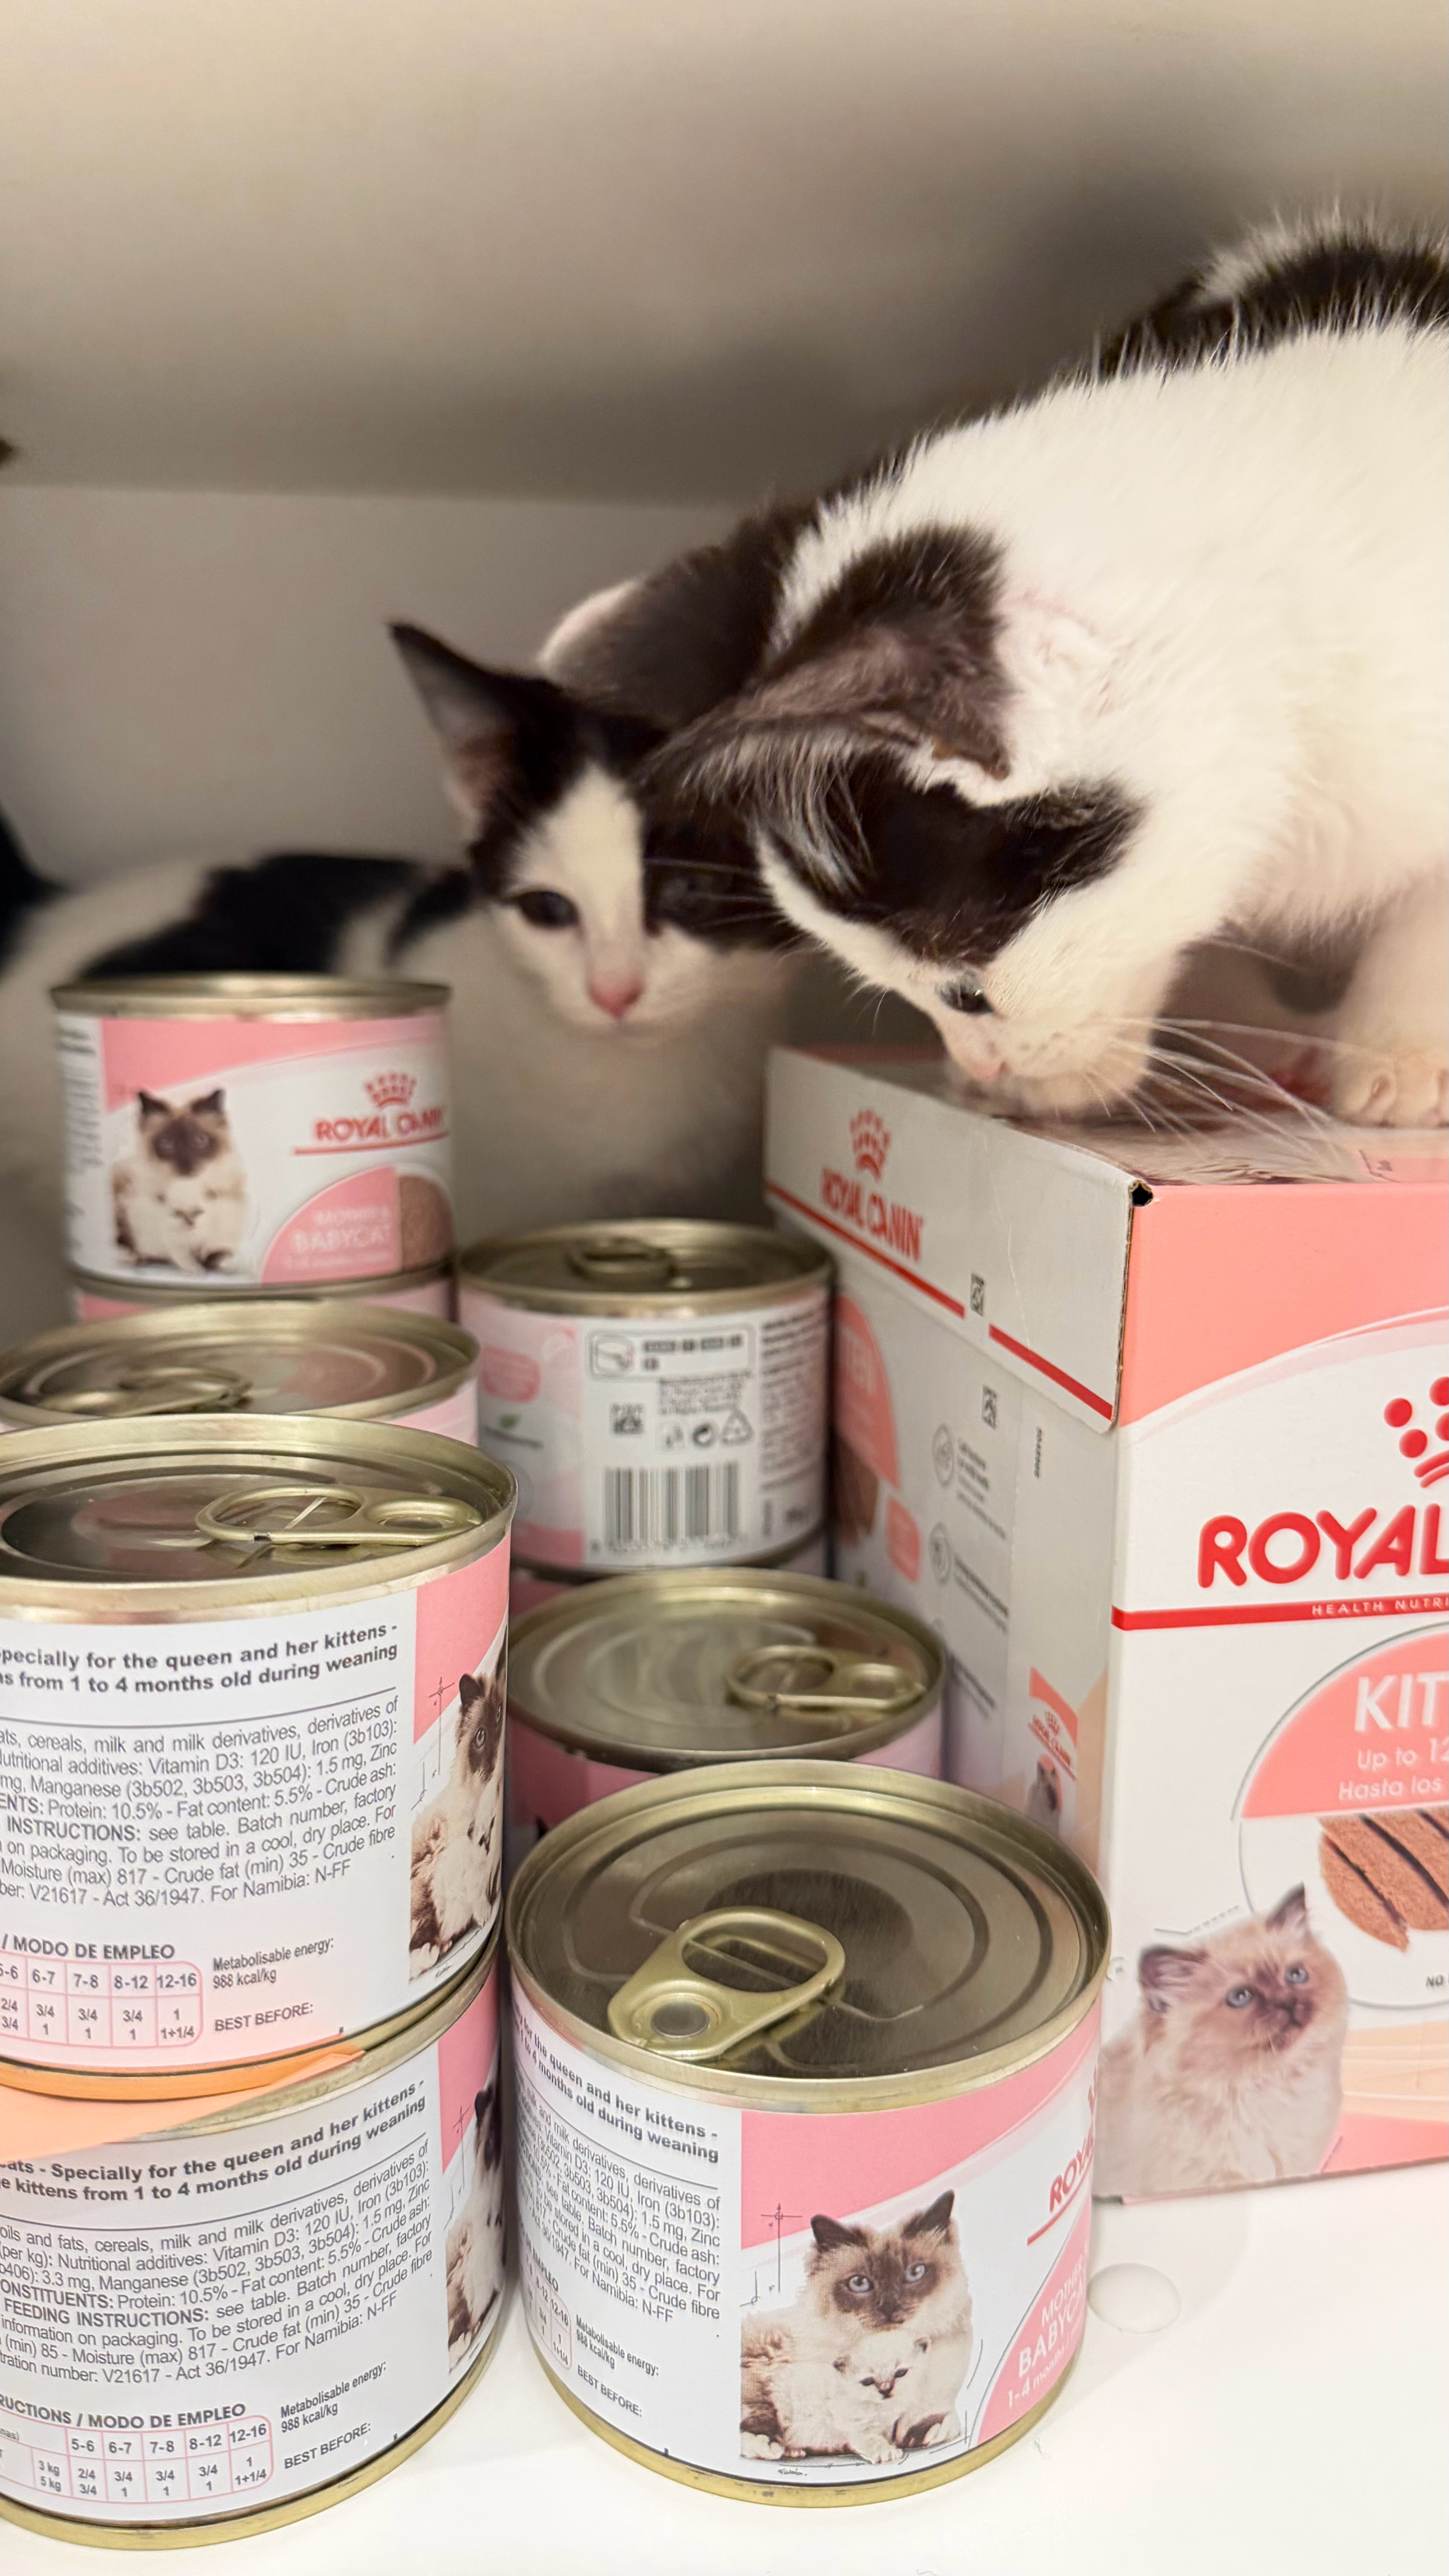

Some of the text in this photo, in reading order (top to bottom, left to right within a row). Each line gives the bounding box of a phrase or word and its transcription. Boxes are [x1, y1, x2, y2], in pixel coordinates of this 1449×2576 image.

[1197, 1503, 1449, 1588] ROYAL
[1311, 1601, 1383, 1616] HEALTH
[0, 1647, 79, 1671] pecially
[87, 1652, 116, 1669] for
[124, 1653, 158, 1669] the
[166, 1652, 232, 1671] queen
[240, 1643, 278, 1663] and
[286, 1639, 319, 1657] her
[324, 1624, 387, 1650] kittens
[19, 1671, 64, 1690] from
[71, 1676, 80, 1691] 1
[88, 1677, 110, 1693] to
[115, 1677, 128, 1693] 4
[135, 1675, 214, 1693] months
[221, 1670, 252, 1688] old
[258, 1664, 320, 1684] during
[326, 1643, 397, 1673] weaning
[28, 1695, 399, 1754] cereals, milk and milk derivatives, derivatives of
[68, 1719, 397, 1775] additives: Vitamin D3: 120 IU, Iron (3b103):
[0, 1742, 397, 1802] mg, Manganese (3b502, 3b503, 3b504): 1.5 mg, Zinc
[1357, 1748, 1387, 1772] Up
[1395, 1747, 1417, 1766] to
[1338, 1776, 1443, 1800] Hasta los
[14, 1935, 175, 1960] MODO DE EMPLEO
[213, 1937, 334, 1972] Metabolisable energy:
[212, 1968, 276, 1989] 988 kcal/kg
[215, 2002, 313, 2031] BEST BEFORE:
[534, 2033, 547, 2058] the
[550, 2053, 583, 2088] queen
[587, 2082, 611, 2104] and
[616, 2094, 641, 2117] her
[646, 2107, 705, 2138] kittens
[51, 2163, 142, 2183] Specially
[148, 2168, 178, 2178] for
[184, 2159, 217, 2174] the
[224, 2144, 284, 2171] queen
[290, 2128, 324, 2151] and
[330, 2114, 359, 2137] her
[363, 2084, 415, 2121] kittens
[539, 2061, 573, 2099] months
[576, 2095, 594, 2114] old
[598, 2107, 643, 2140] during
[647, 2130, 718, 2163] weaning
[16, 2178, 78, 2199] kittens
[83, 2186, 128, 2200] from
[134, 2186, 144, 2199] 1
[151, 2186, 172, 2199] to
[177, 2182, 190, 2195] 4
[196, 2168, 269, 2194] months
[275, 2156, 302, 2176] old
[308, 2134, 361, 2165] during
[366, 2095, 426, 2140] weaning
[573, 2138, 721, 2210] derivatives, derivatives of
[595, 2169, 719, 2231] 120 IU, Iron (3b103):
[41, 2364, 98, 2382] number:
[102, 2368, 160, 2383] V21617
[175, 2364, 201, 2381] Act
[206, 2350, 270, 2377] 36/1947.
[276, 2341, 300, 2360] For
[305, 2313, 363, 2350] Namibia:
[367, 2290, 397, 2320] N-FF
[576, 2314, 659, 2376] Metabolisable energy:
[590, 2340, 615, 2369] kcal/kg
[281, 2361, 386, 2418] Metabolisable energy:
[578, 2364, 643, 2417] BEST BEFORE:
[1008, 2376, 1030, 2408] 1-4
[71, 2424, 267, 2454] 5-6 6-7 7-8 8-12 12-16
[88, 2414, 144, 2429] MODO
[150, 2415, 172, 2427] DE
[177, 2403, 246, 2426] EMPLEO
[281, 2402, 338, 2433] 988 kcal/kg
[284, 2422, 371, 2469] BEST BEFORE:
[38, 2457, 252, 2482] 3 kg 2/4 3/4 3/4 3/4 1
[41, 2469, 267, 2497] 5 kg 3/4 1 1 1 1+1/4
